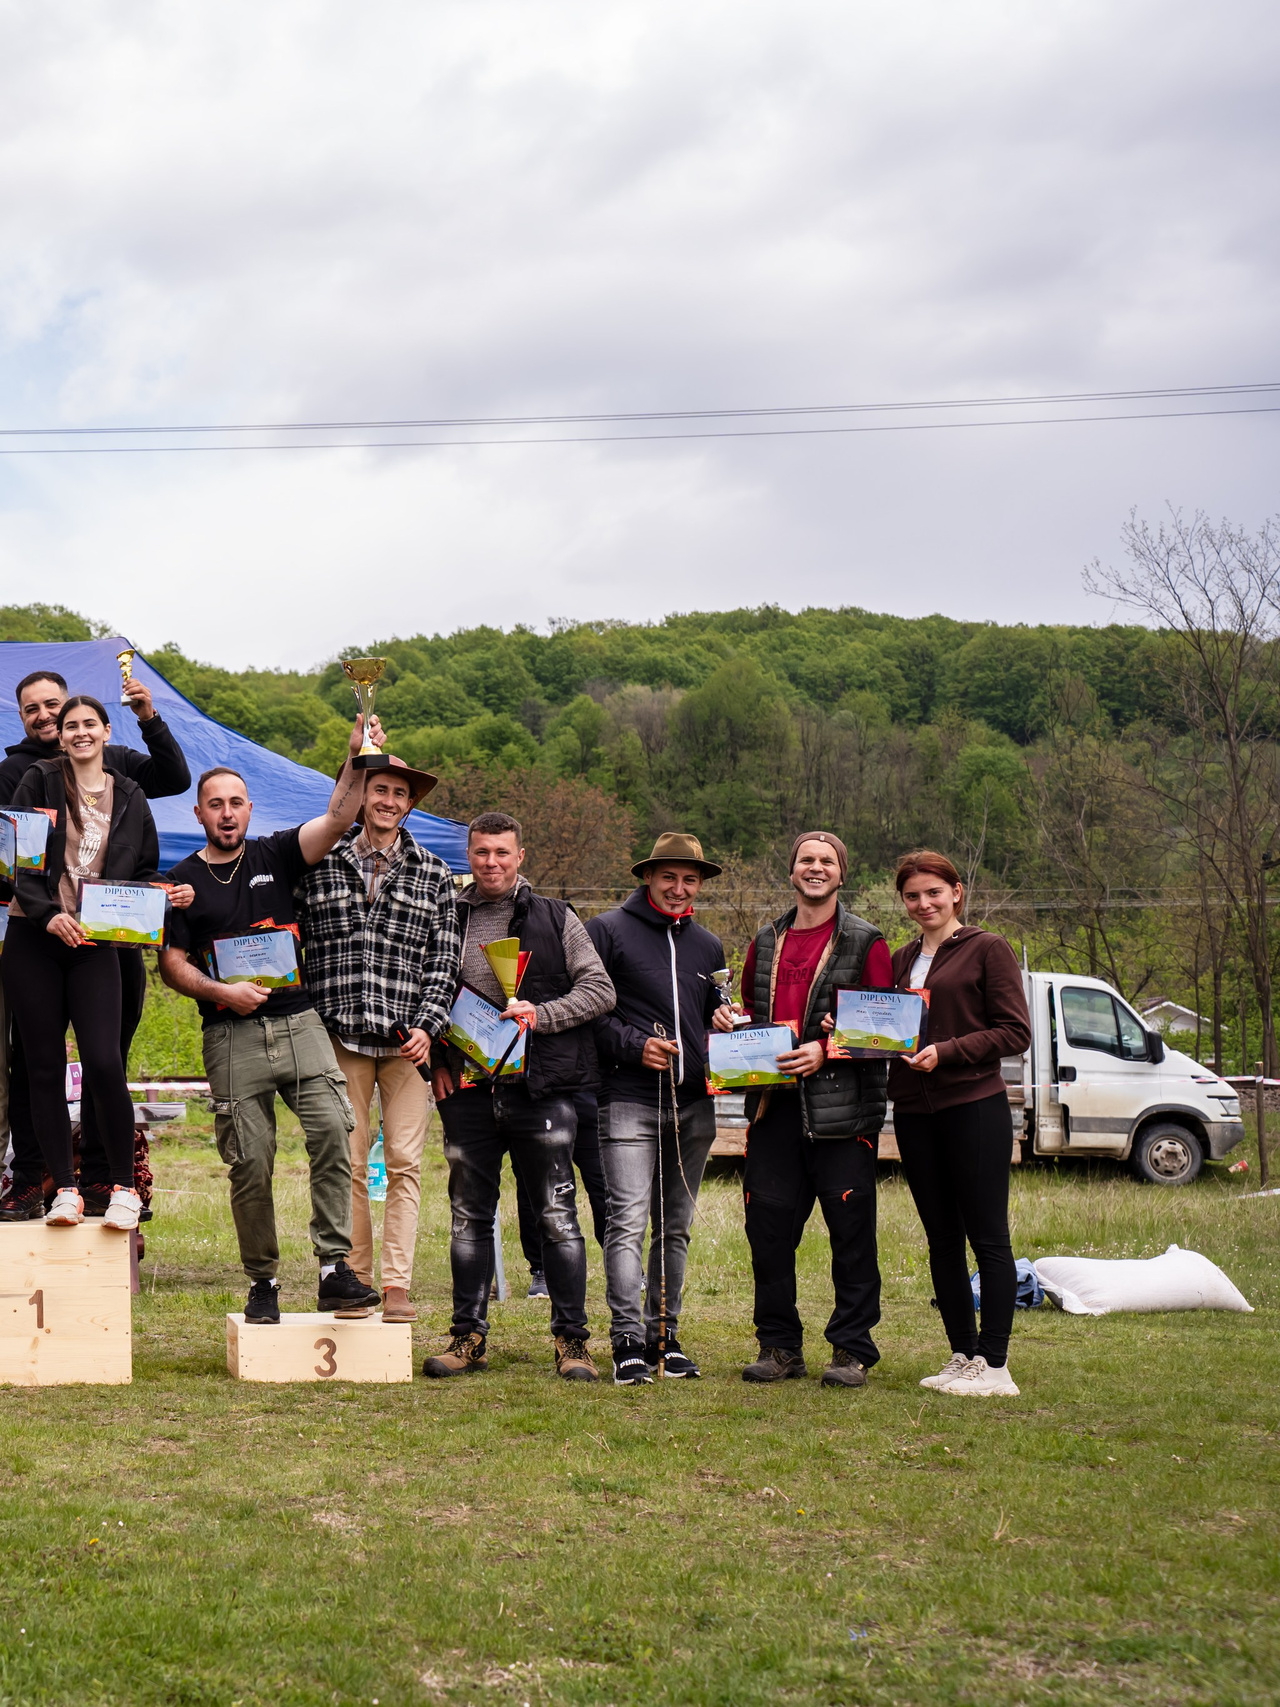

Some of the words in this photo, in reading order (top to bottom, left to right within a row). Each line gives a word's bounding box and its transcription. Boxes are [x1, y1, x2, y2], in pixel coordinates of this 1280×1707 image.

[28, 1289, 44, 1329] 1
[313, 1337, 337, 1378] 3
[619, 1358, 646, 1369] PUMA
